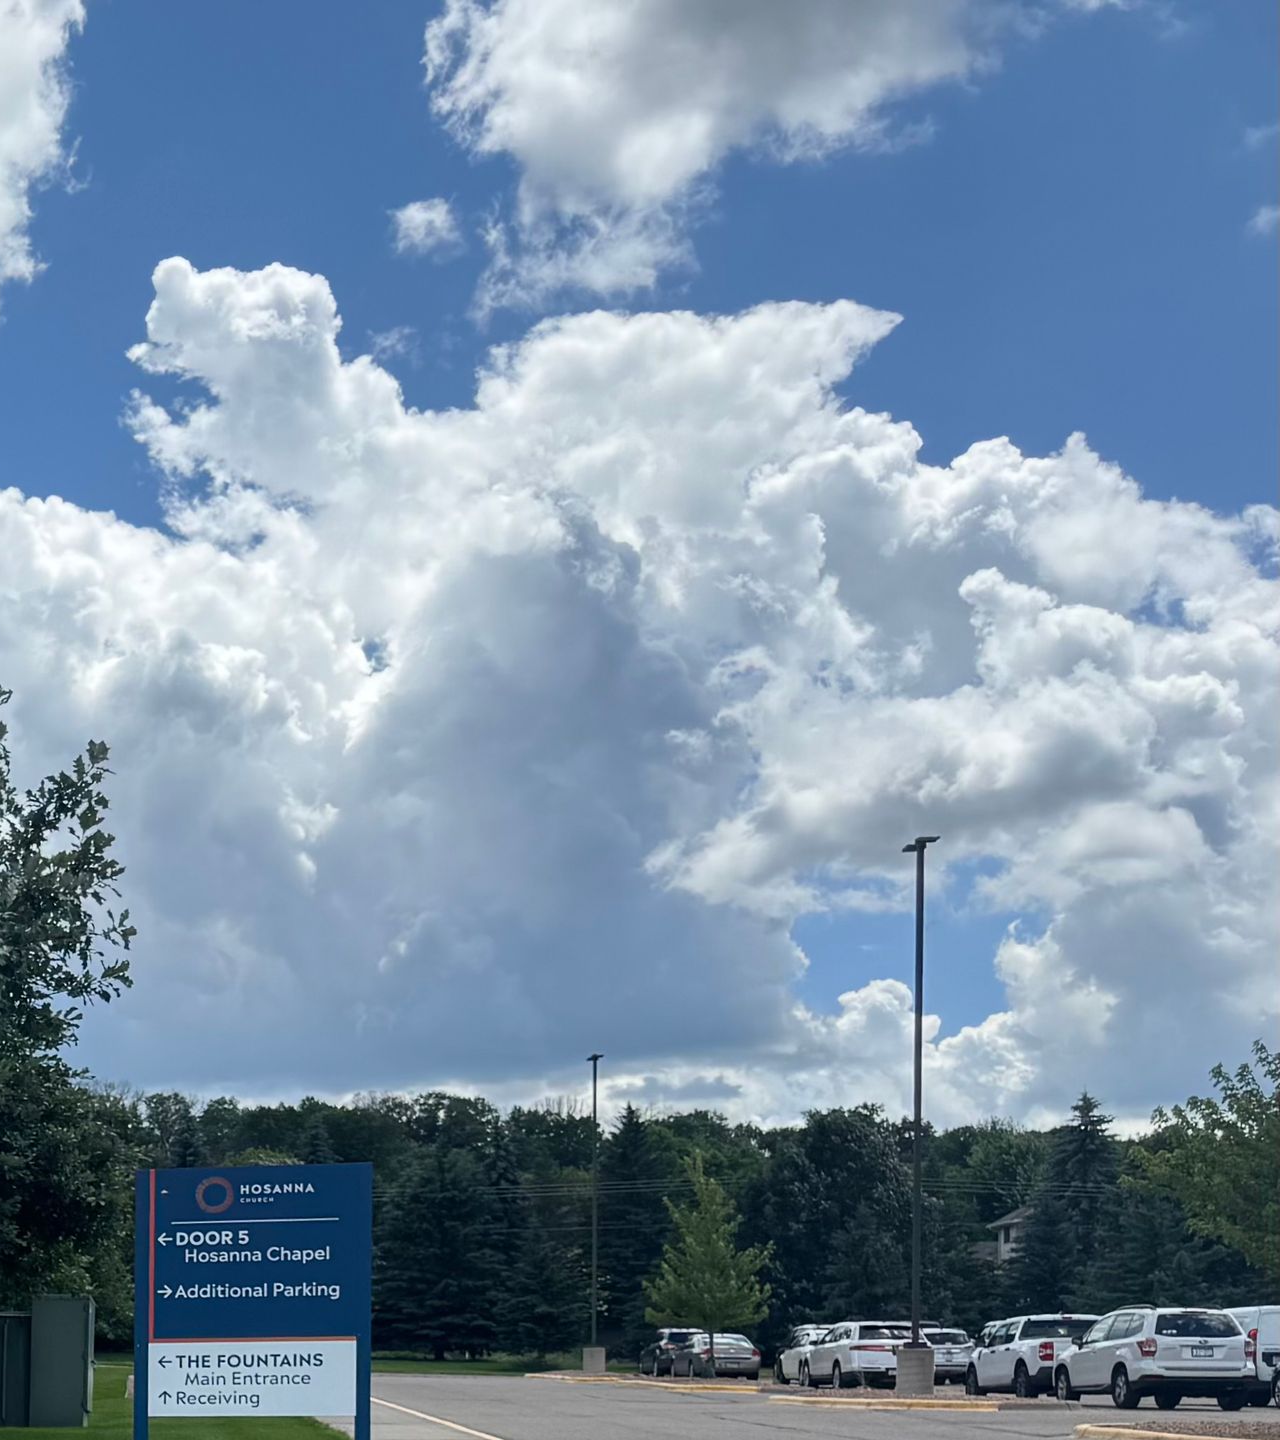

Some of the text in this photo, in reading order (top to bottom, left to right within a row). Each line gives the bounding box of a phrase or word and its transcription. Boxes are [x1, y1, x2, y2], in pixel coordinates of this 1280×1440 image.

[240, 1183, 315, 1195] HOSANNA
[175, 1230, 250, 1246] DOOR 5
[184, 1246, 330, 1264] Hosanna Chapel
[174, 1281, 341, 1300] Additional Parking
[175, 1352, 324, 1369] THE FOUNTAINS
[184, 1371, 312, 1386] Main Entrance
[175, 1390, 260, 1408] Receiving
